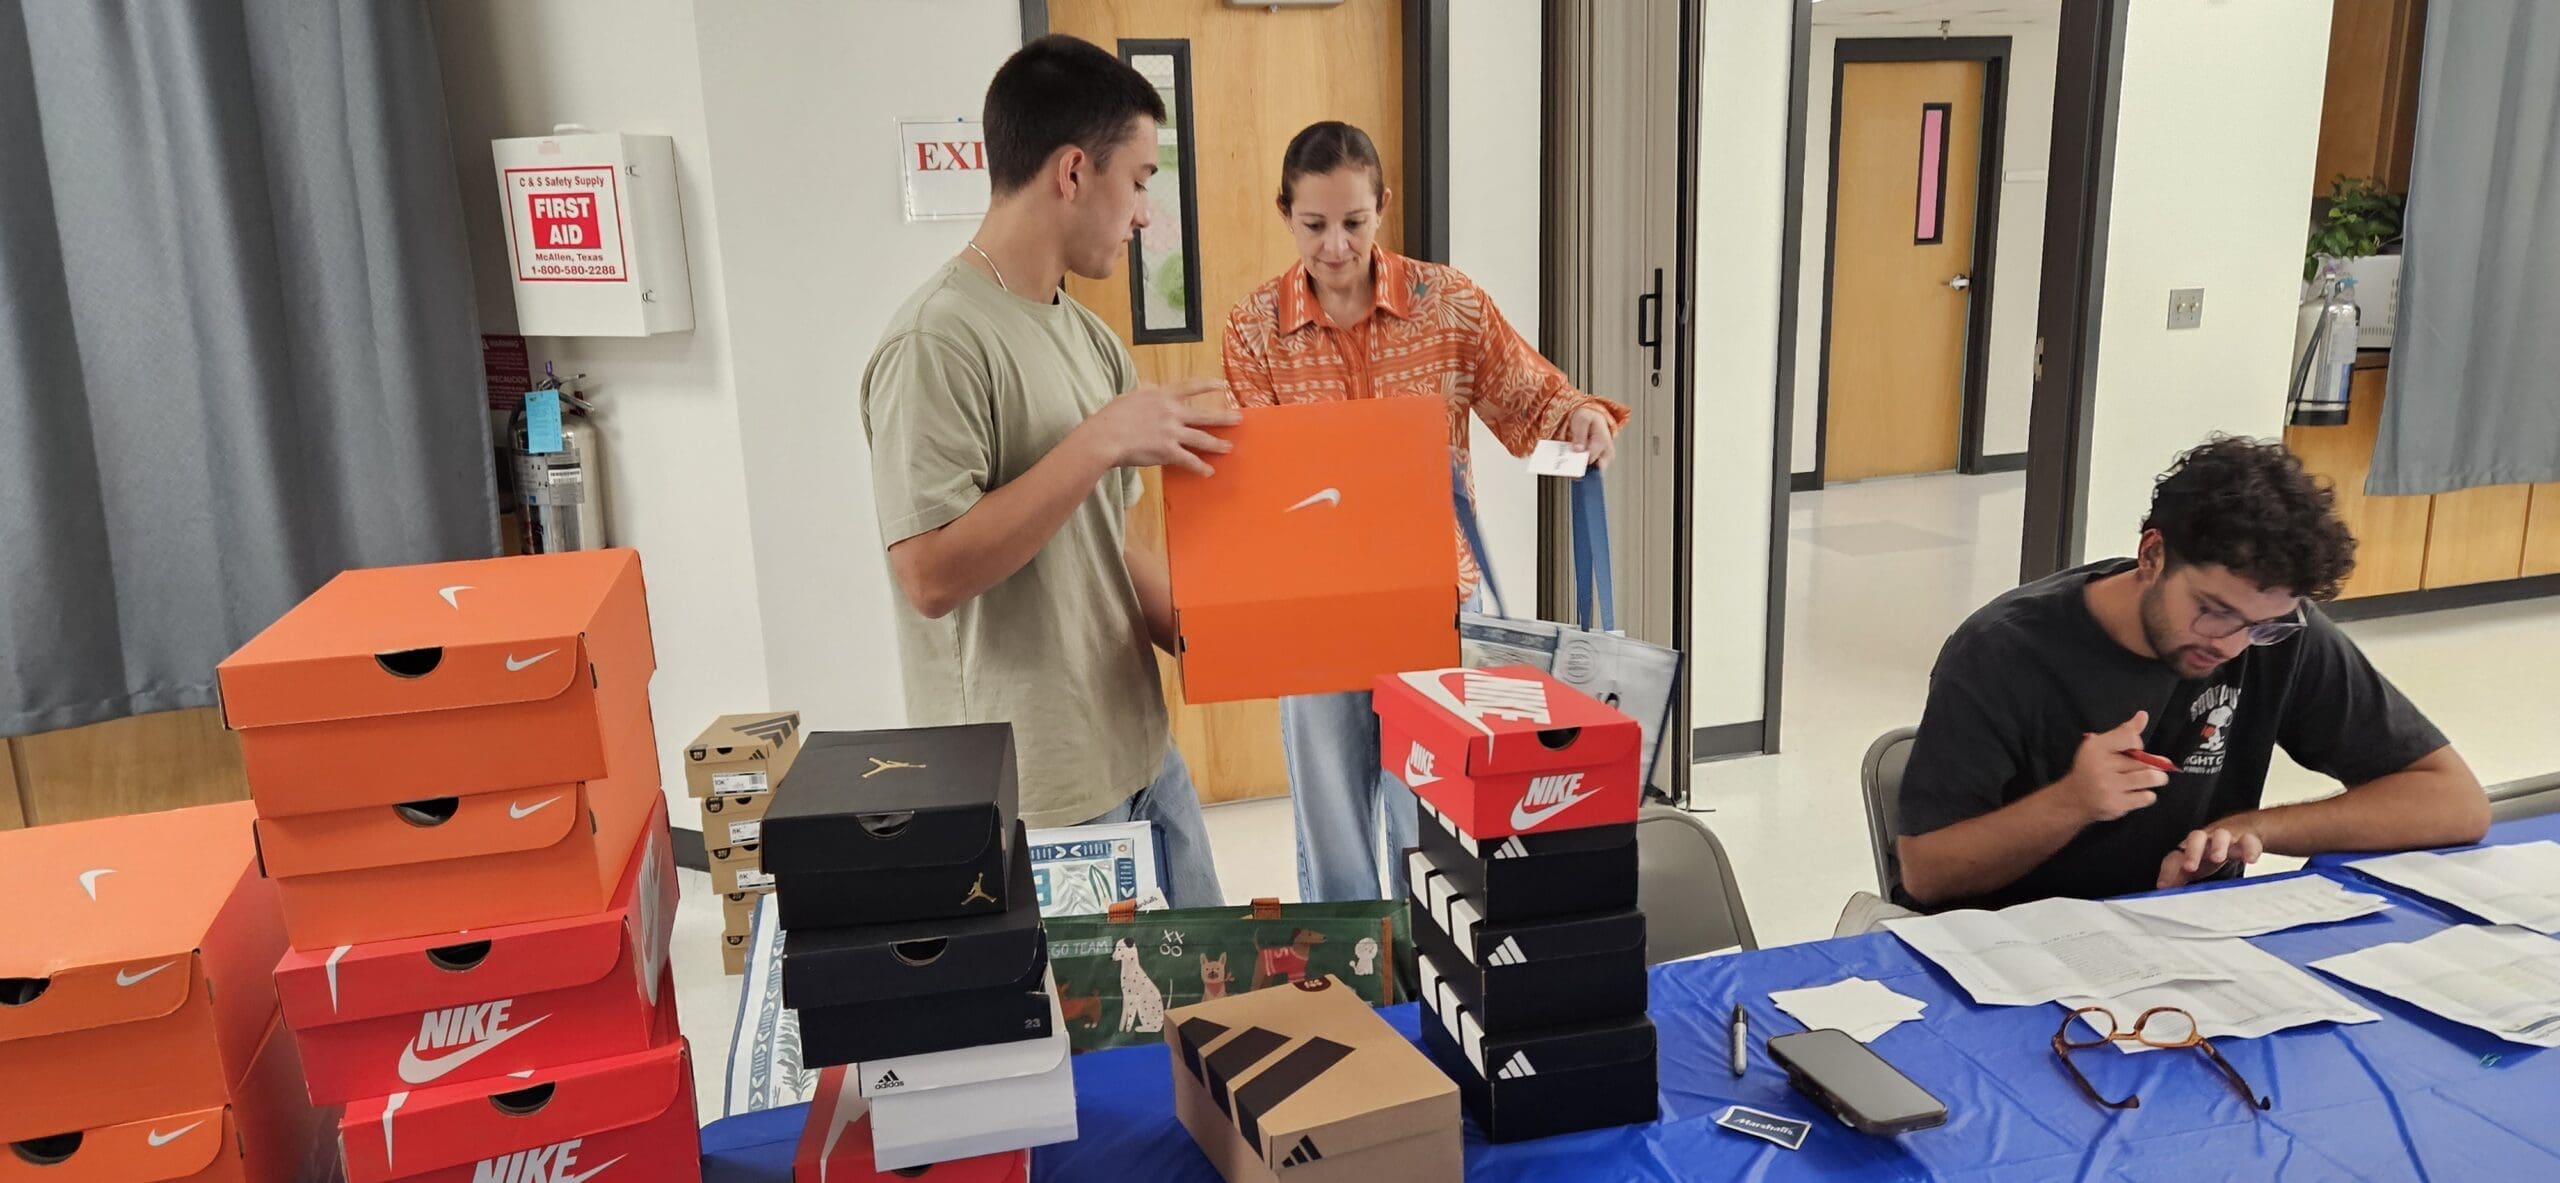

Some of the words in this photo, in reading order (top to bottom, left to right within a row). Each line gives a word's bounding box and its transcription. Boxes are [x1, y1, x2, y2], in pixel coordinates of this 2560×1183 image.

[914, 141, 986, 171] EXI
[519, 177, 526, 187] C
[528, 177, 535, 187] &
[537, 176, 543, 187] S
[545, 176, 572, 188] Safety
[575, 175, 605, 188] Supply
[534, 197, 591, 219] FIRST
[549, 224, 584, 246] AID
[535, 253, 575, 263] McAllen,
[578, 253, 604, 262] Texas
[531, 265, 616, 275] 1-800-580-2288
[1463, 672, 1552, 725] NIKE
[1410, 740, 1436, 778] NIKE
[1523, 772, 1585, 808] NIKE
[1051, 944, 1071, 957] GO
[1073, 940, 1110, 955] TEAM
[416, 998, 513, 1052] NIKE
[1024, 1018, 1041, 1029] 23
[874, 1080, 905, 1090] adidas
[472, 1138, 584, 1183] NIKE
